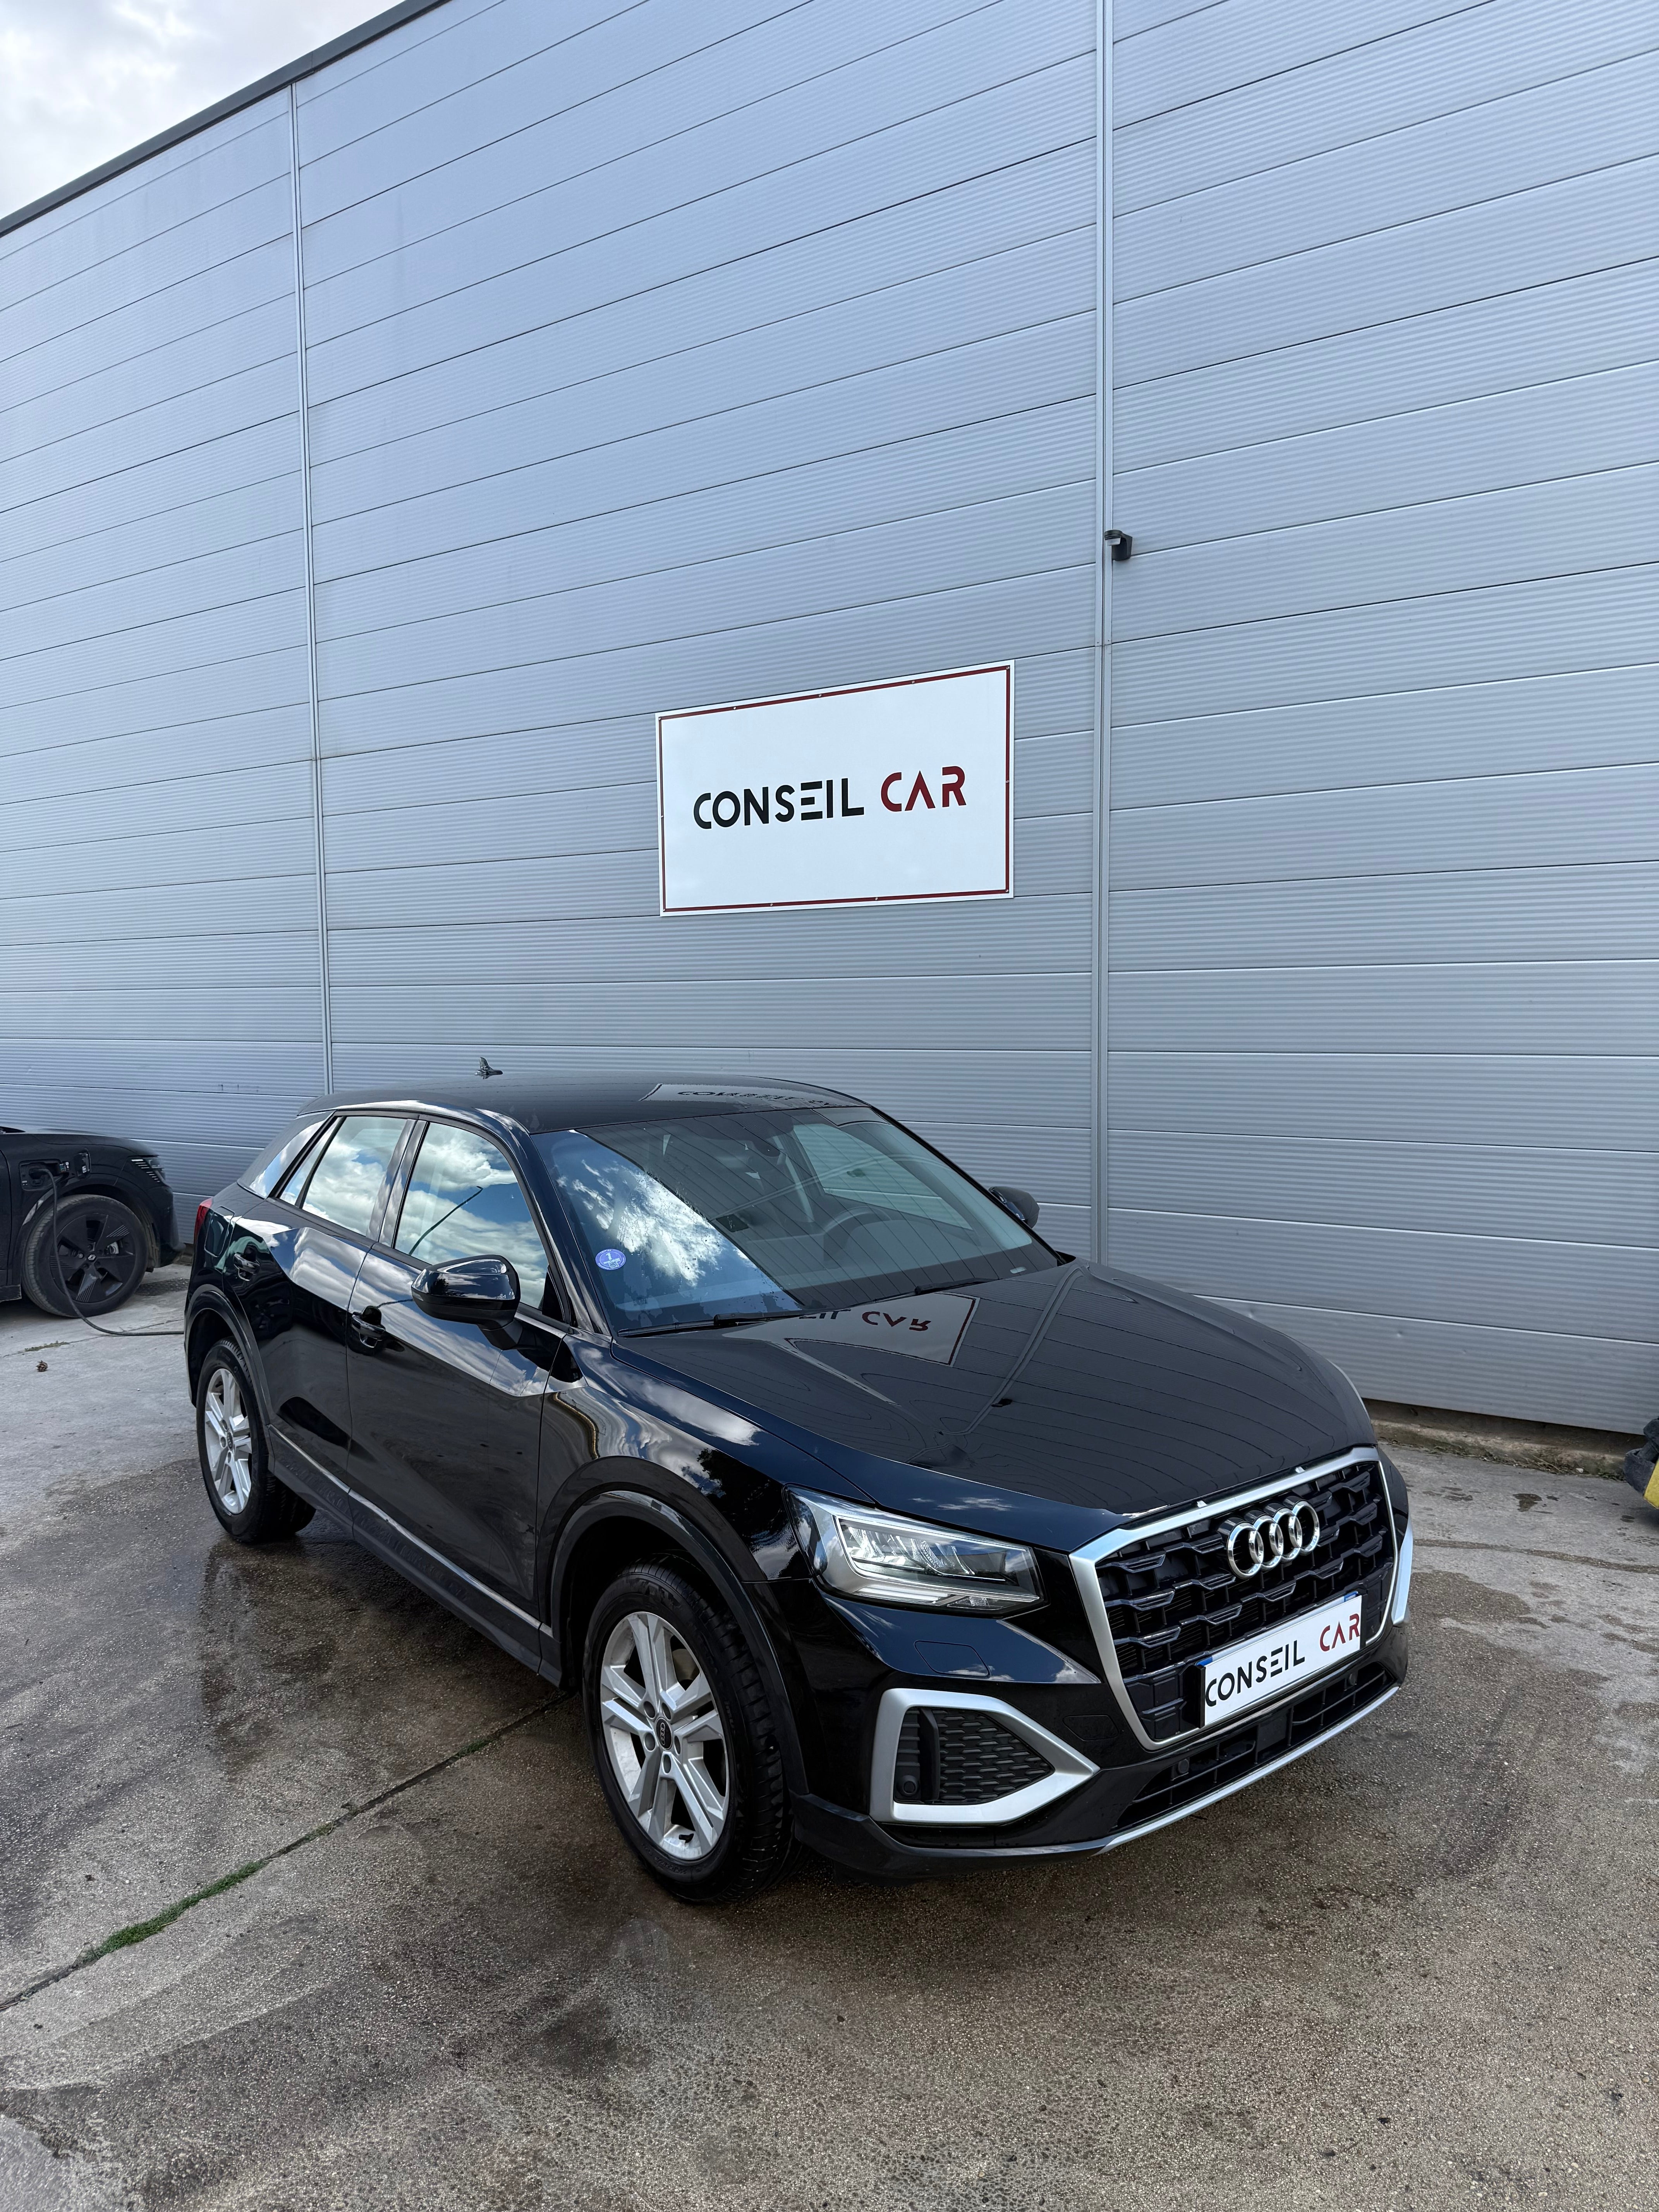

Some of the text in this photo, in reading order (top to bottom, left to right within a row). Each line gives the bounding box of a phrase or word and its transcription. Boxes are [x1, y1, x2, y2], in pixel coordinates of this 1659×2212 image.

[693, 766, 967, 830] CONSEIL CAR
[1205, 1613, 1360, 1707] CONSEIL CAR
